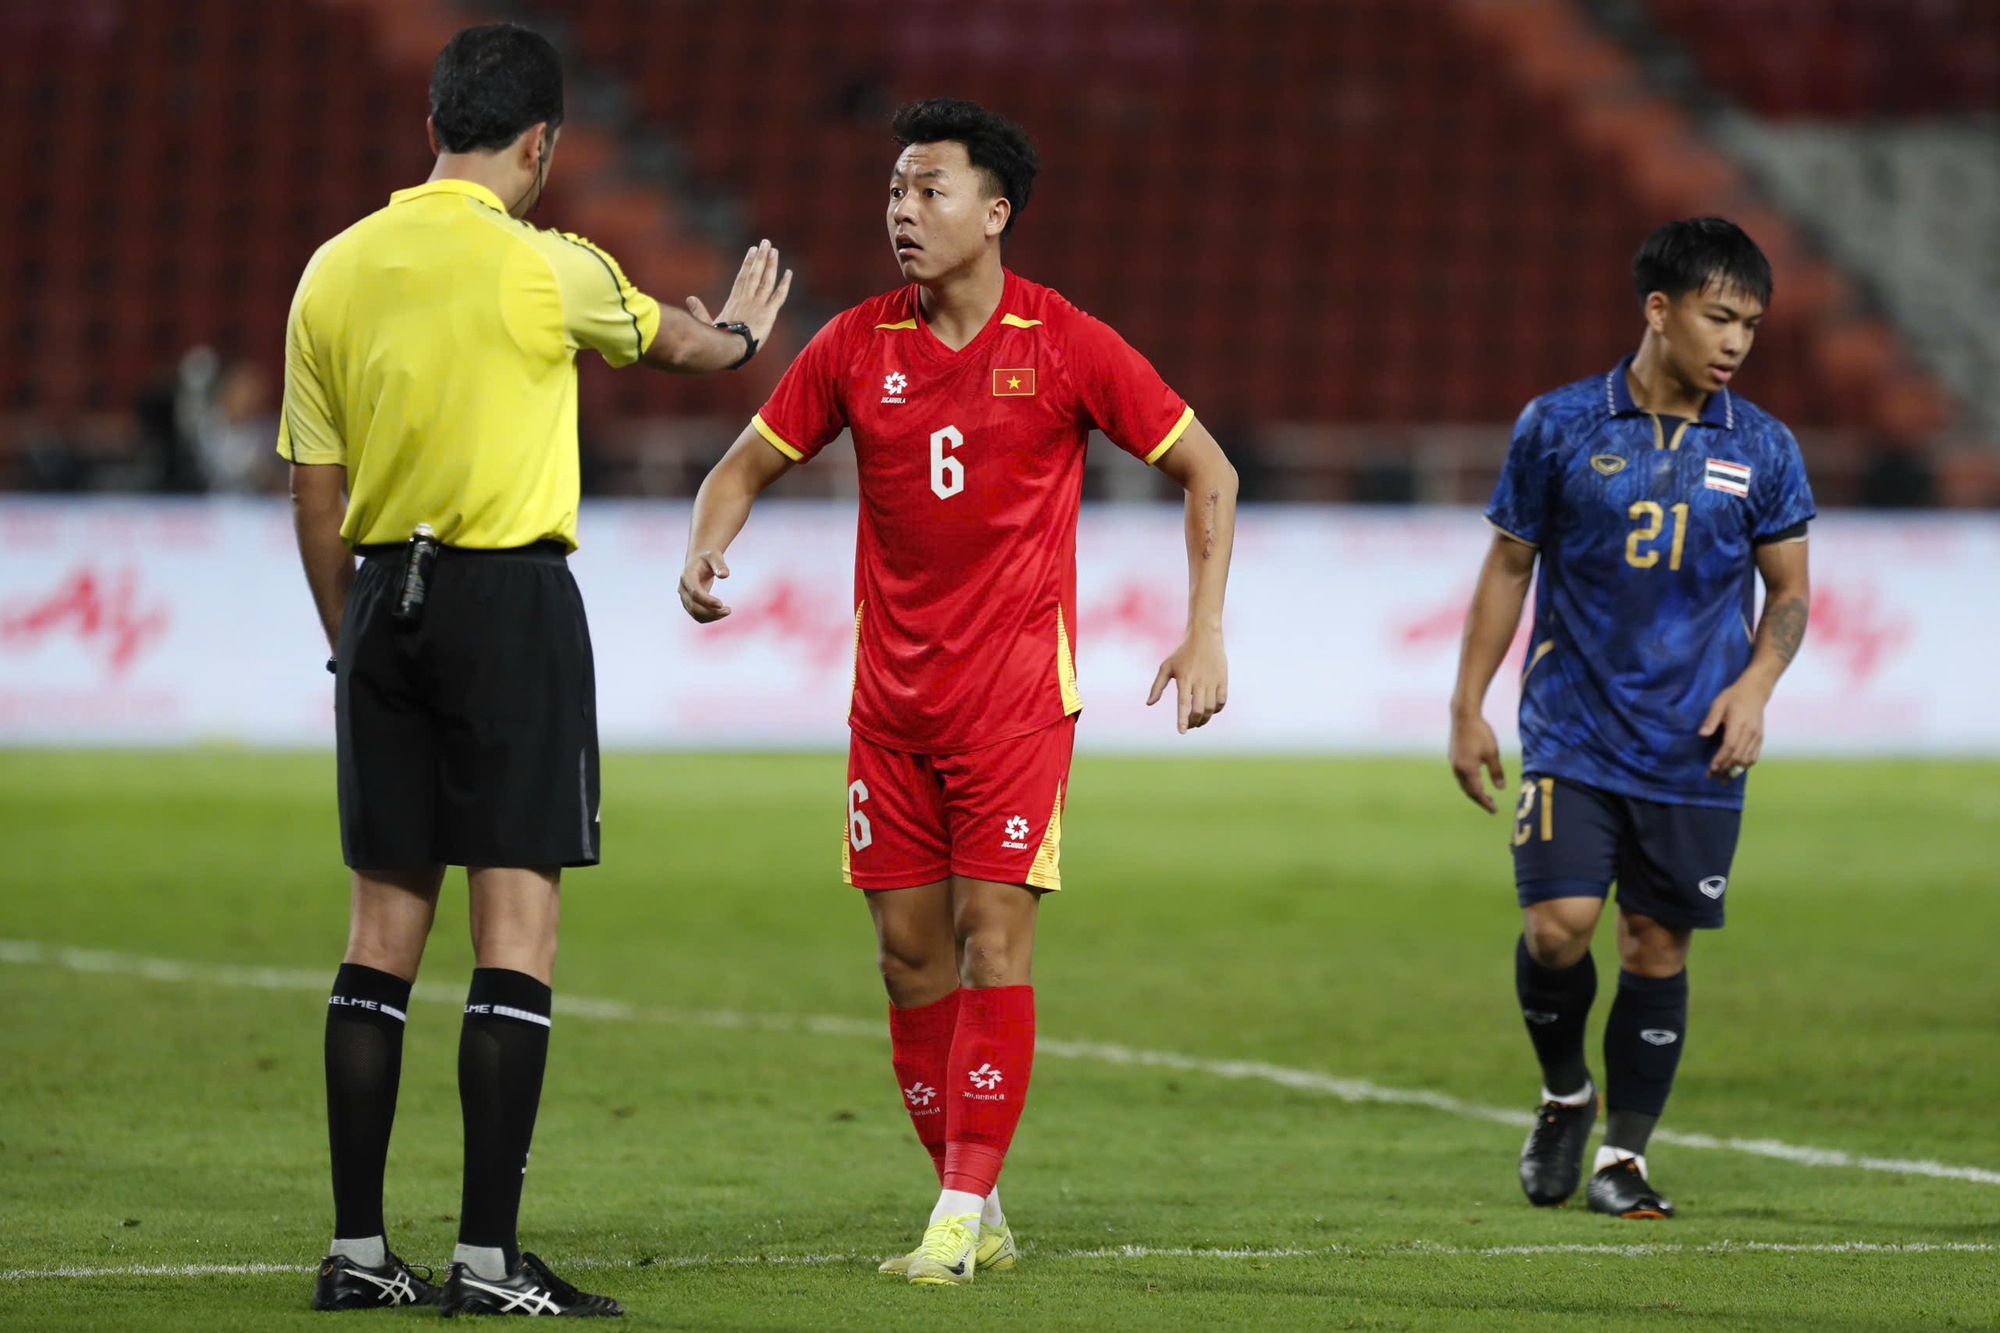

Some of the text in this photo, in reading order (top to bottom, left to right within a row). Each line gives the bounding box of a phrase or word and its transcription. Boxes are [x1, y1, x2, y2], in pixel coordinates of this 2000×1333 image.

[930, 424, 964, 500] 6
[1625, 500, 1689, 571] 21
[848, 779, 872, 852] 6
[1514, 778, 1554, 846] 21
